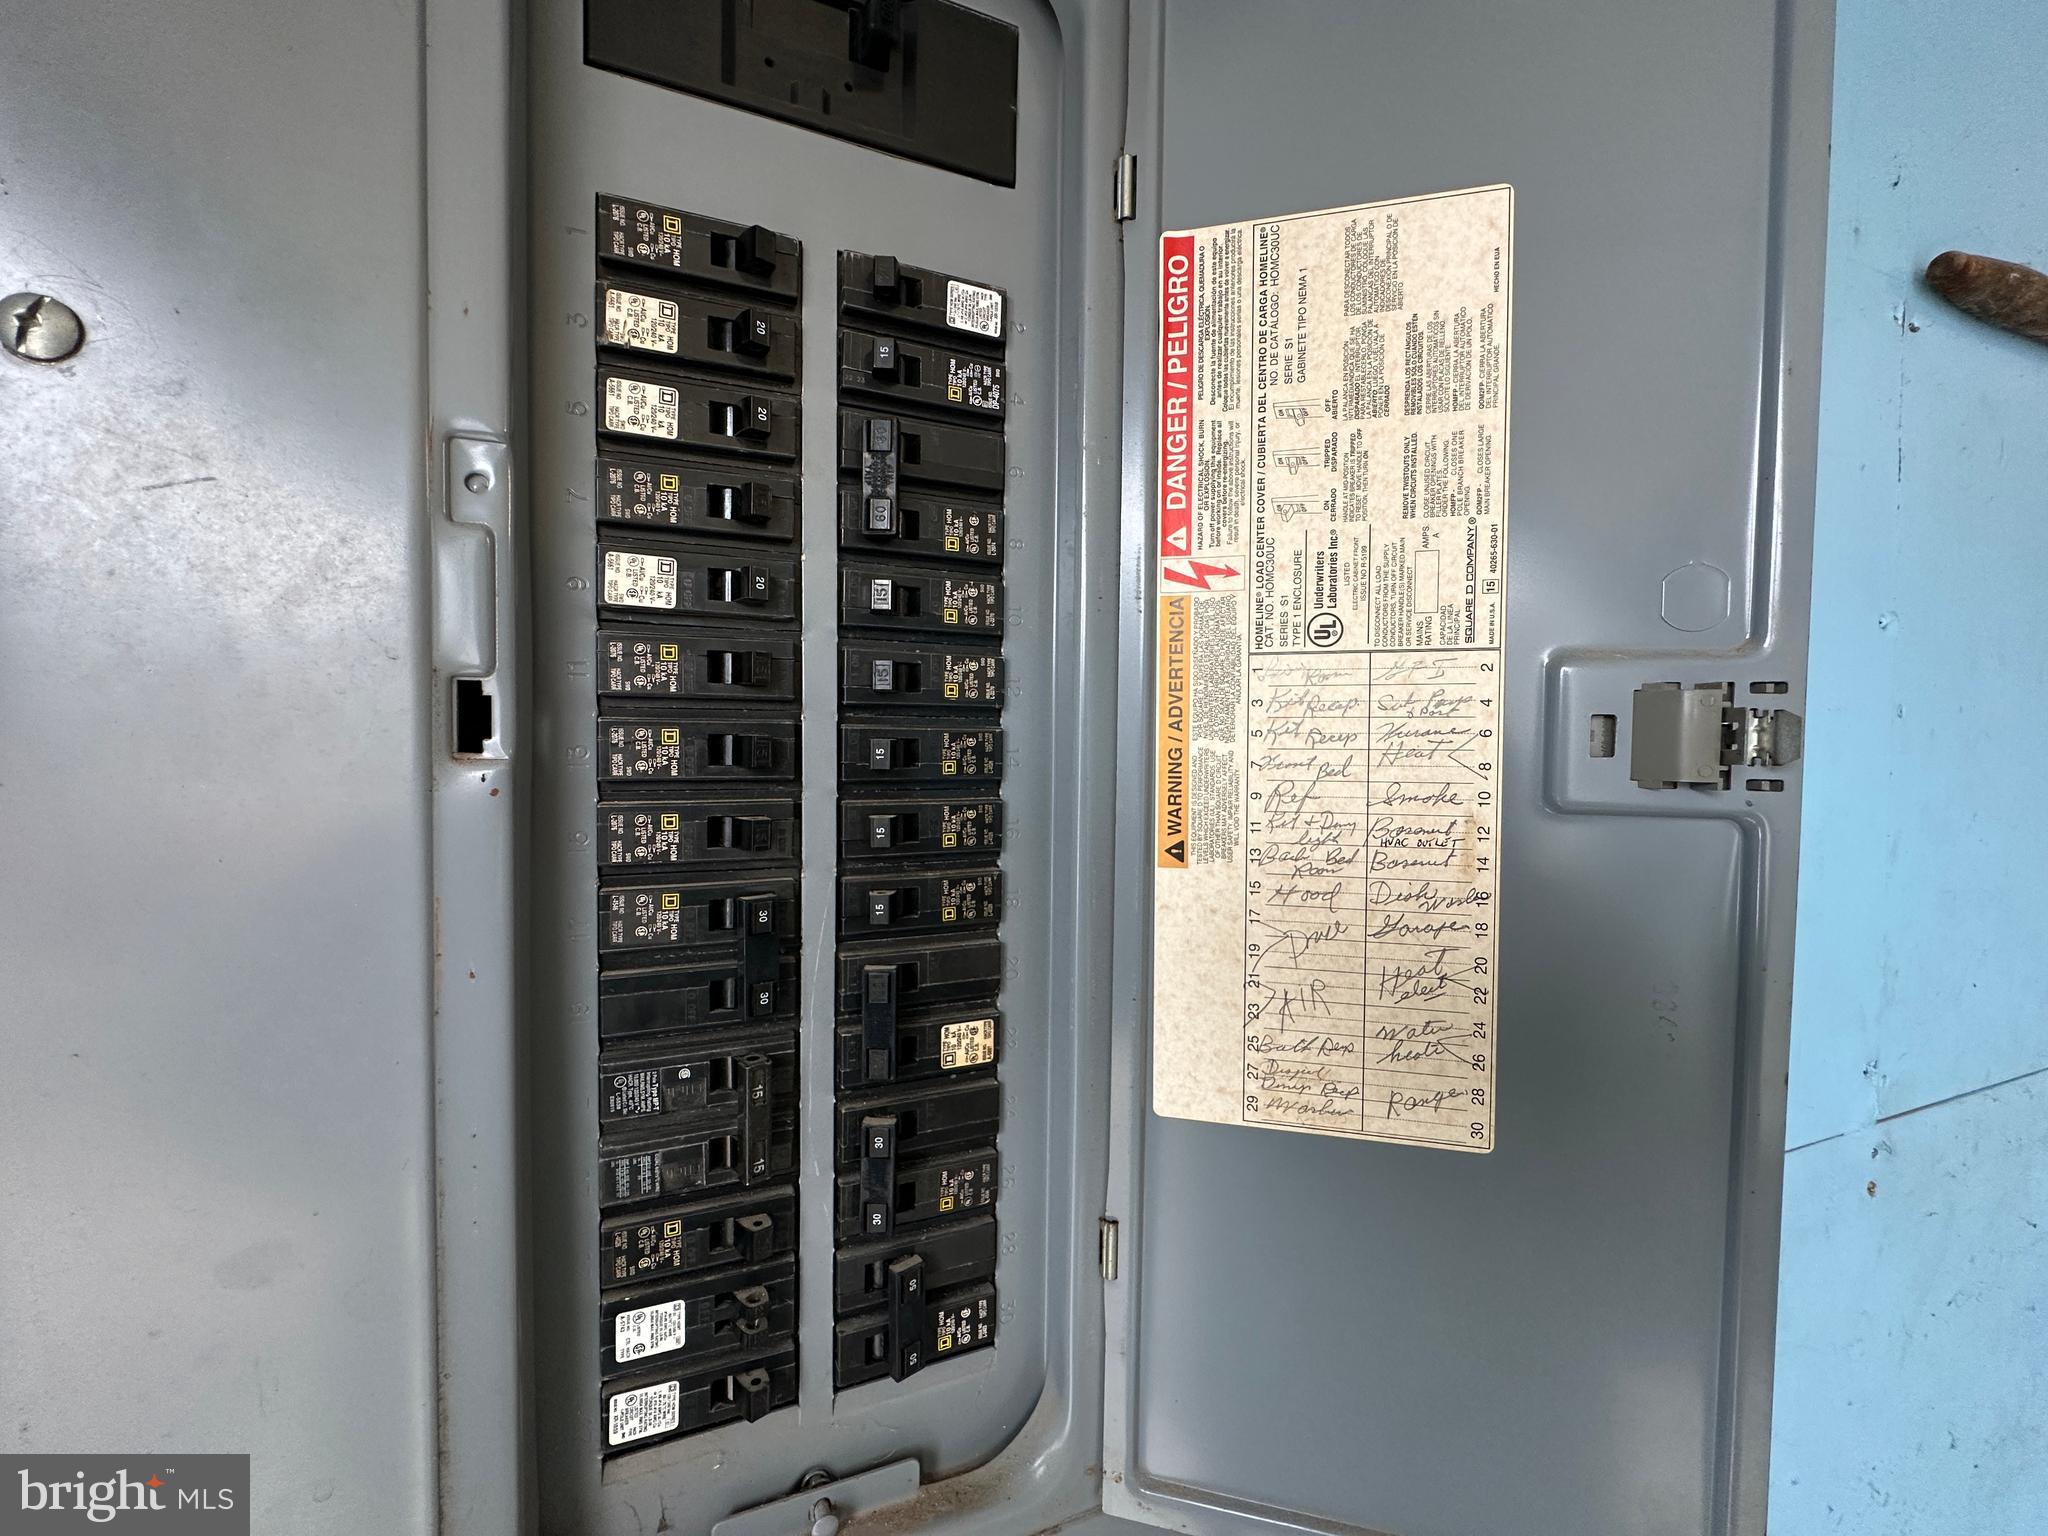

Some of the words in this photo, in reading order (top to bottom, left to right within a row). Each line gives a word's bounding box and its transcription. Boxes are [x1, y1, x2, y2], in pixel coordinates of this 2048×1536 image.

[672, 249, 681, 267] HOM
[1271, 224, 1280, 286] HOMC30UC
[1494, 261, 1499, 270] EN
[1298, 275, 1307, 304] NEMA
[1169, 255, 1189, 374] PELIGRO
[1259, 289, 1268, 327] CARGA
[1298, 308, 1307, 330] TIPO
[756, 320, 766, 335] 20
[1259, 329, 1267, 343] DE
[1285, 338, 1293, 349] S1
[880, 346, 889, 358] 15
[1270, 352, 1278, 365] DE
[1298, 333, 1307, 383] GABINETE
[1258, 347, 1267, 389] CENTRO
[1284, 355, 1293, 384] SERIE
[1270, 369, 1278, 385] NO.
[1168, 381, 1188, 389] /
[1258, 393, 1267, 413] DEL
[758, 407, 767, 421] 20
[1258, 416, 1266, 468] CUBIERTA
[1168, 397, 1187, 510] DANGER
[1257, 478, 1266, 513] COVER
[1324, 500, 1330, 511] ON
[1257, 517, 1265, 557] CENTER
[1490, 523, 1498, 573] 40265-630-01
[1256, 560, 1264, 589] LOAD
[1266, 537, 1275, 598] HOMC30UC
[755, 577, 765, 590] 20
[1293, 549, 1302, 610] ENCLOSURE
[1314, 551, 1324, 609] Underwriters
[1327, 553, 1338, 608] Laboratories
[1487, 581, 1496, 592] 15
[1466, 585, 1473, 594] D
[1280, 595, 1288, 606] S1
[1266, 601, 1274, 620] NO.
[1465, 598, 1473, 643] SQUARE
[1265, 623, 1274, 647] CAT.
[1280, 612, 1288, 647] SERIES
[1293, 621, 1301, 646] TYPE
[1448, 625, 1453, 634] LA
[1447, 636, 1453, 645] DE
[1168, 597, 1184, 732] ADVERTENCIA
[1480, 663, 1493, 672] 2
[1252, 699, 1263, 707] 3
[1480, 698, 1493, 706] 4
[1252, 730, 1263, 738] 5
[1479, 729, 1492, 737] 6
[876, 748, 885, 760] 15
[1317, 755, 1353, 779] Bed
[1479, 763, 1491, 771] 8
[1168, 747, 1182, 836] WARNING
[1251, 792, 1262, 800] 9
[1367, 782, 1463, 807] Smoke
[1478, 791, 1491, 807] 10
[876, 827, 885, 839] 15
[1250, 821, 1261, 833] 11
[1477, 826, 1490, 842] 12
[1380, 838, 1409, 847] HVAC
[1417, 838, 1465, 847] OUTLET
[1250, 848, 1261, 862] 13
[1326, 849, 1360, 865] Bed
[1476, 857, 1489, 872] 14
[1250, 881, 1261, 895] 15
[1267, 883, 1341, 912] Hood
[1476, 891, 1488, 907] 16
[759, 910, 768, 923] 30
[875, 904, 884, 915] 15
[1249, 910, 1260, 923] 17
[1476, 923, 1488, 938] 18
[1249, 944, 1260, 958] 19
[1475, 957, 1488, 974] 20
[1248, 974, 1260, 987] 21
[760, 992, 769, 1005] 30
[1474, 987, 1487, 1004] 22
[1248, 1004, 1260, 1019] 23
[1474, 1021, 1486, 1038] 24
[1248, 1036, 1259, 1050] 25
[1473, 1054, 1486, 1071] 26
[1247, 1066, 1259, 1079] 27
[752, 1085, 763, 1100] 15
[1472, 1088, 1484, 1106] 28
[1247, 1096, 1259, 1111] 29
[1471, 1123, 1484, 1139] 30
[875, 1137, 884, 1149] 30
[754, 1158, 765, 1174] 15
[873, 1213, 881, 1225] 30
[909, 1279, 917, 1292] 50
[910, 1353, 917, 1366] 50
